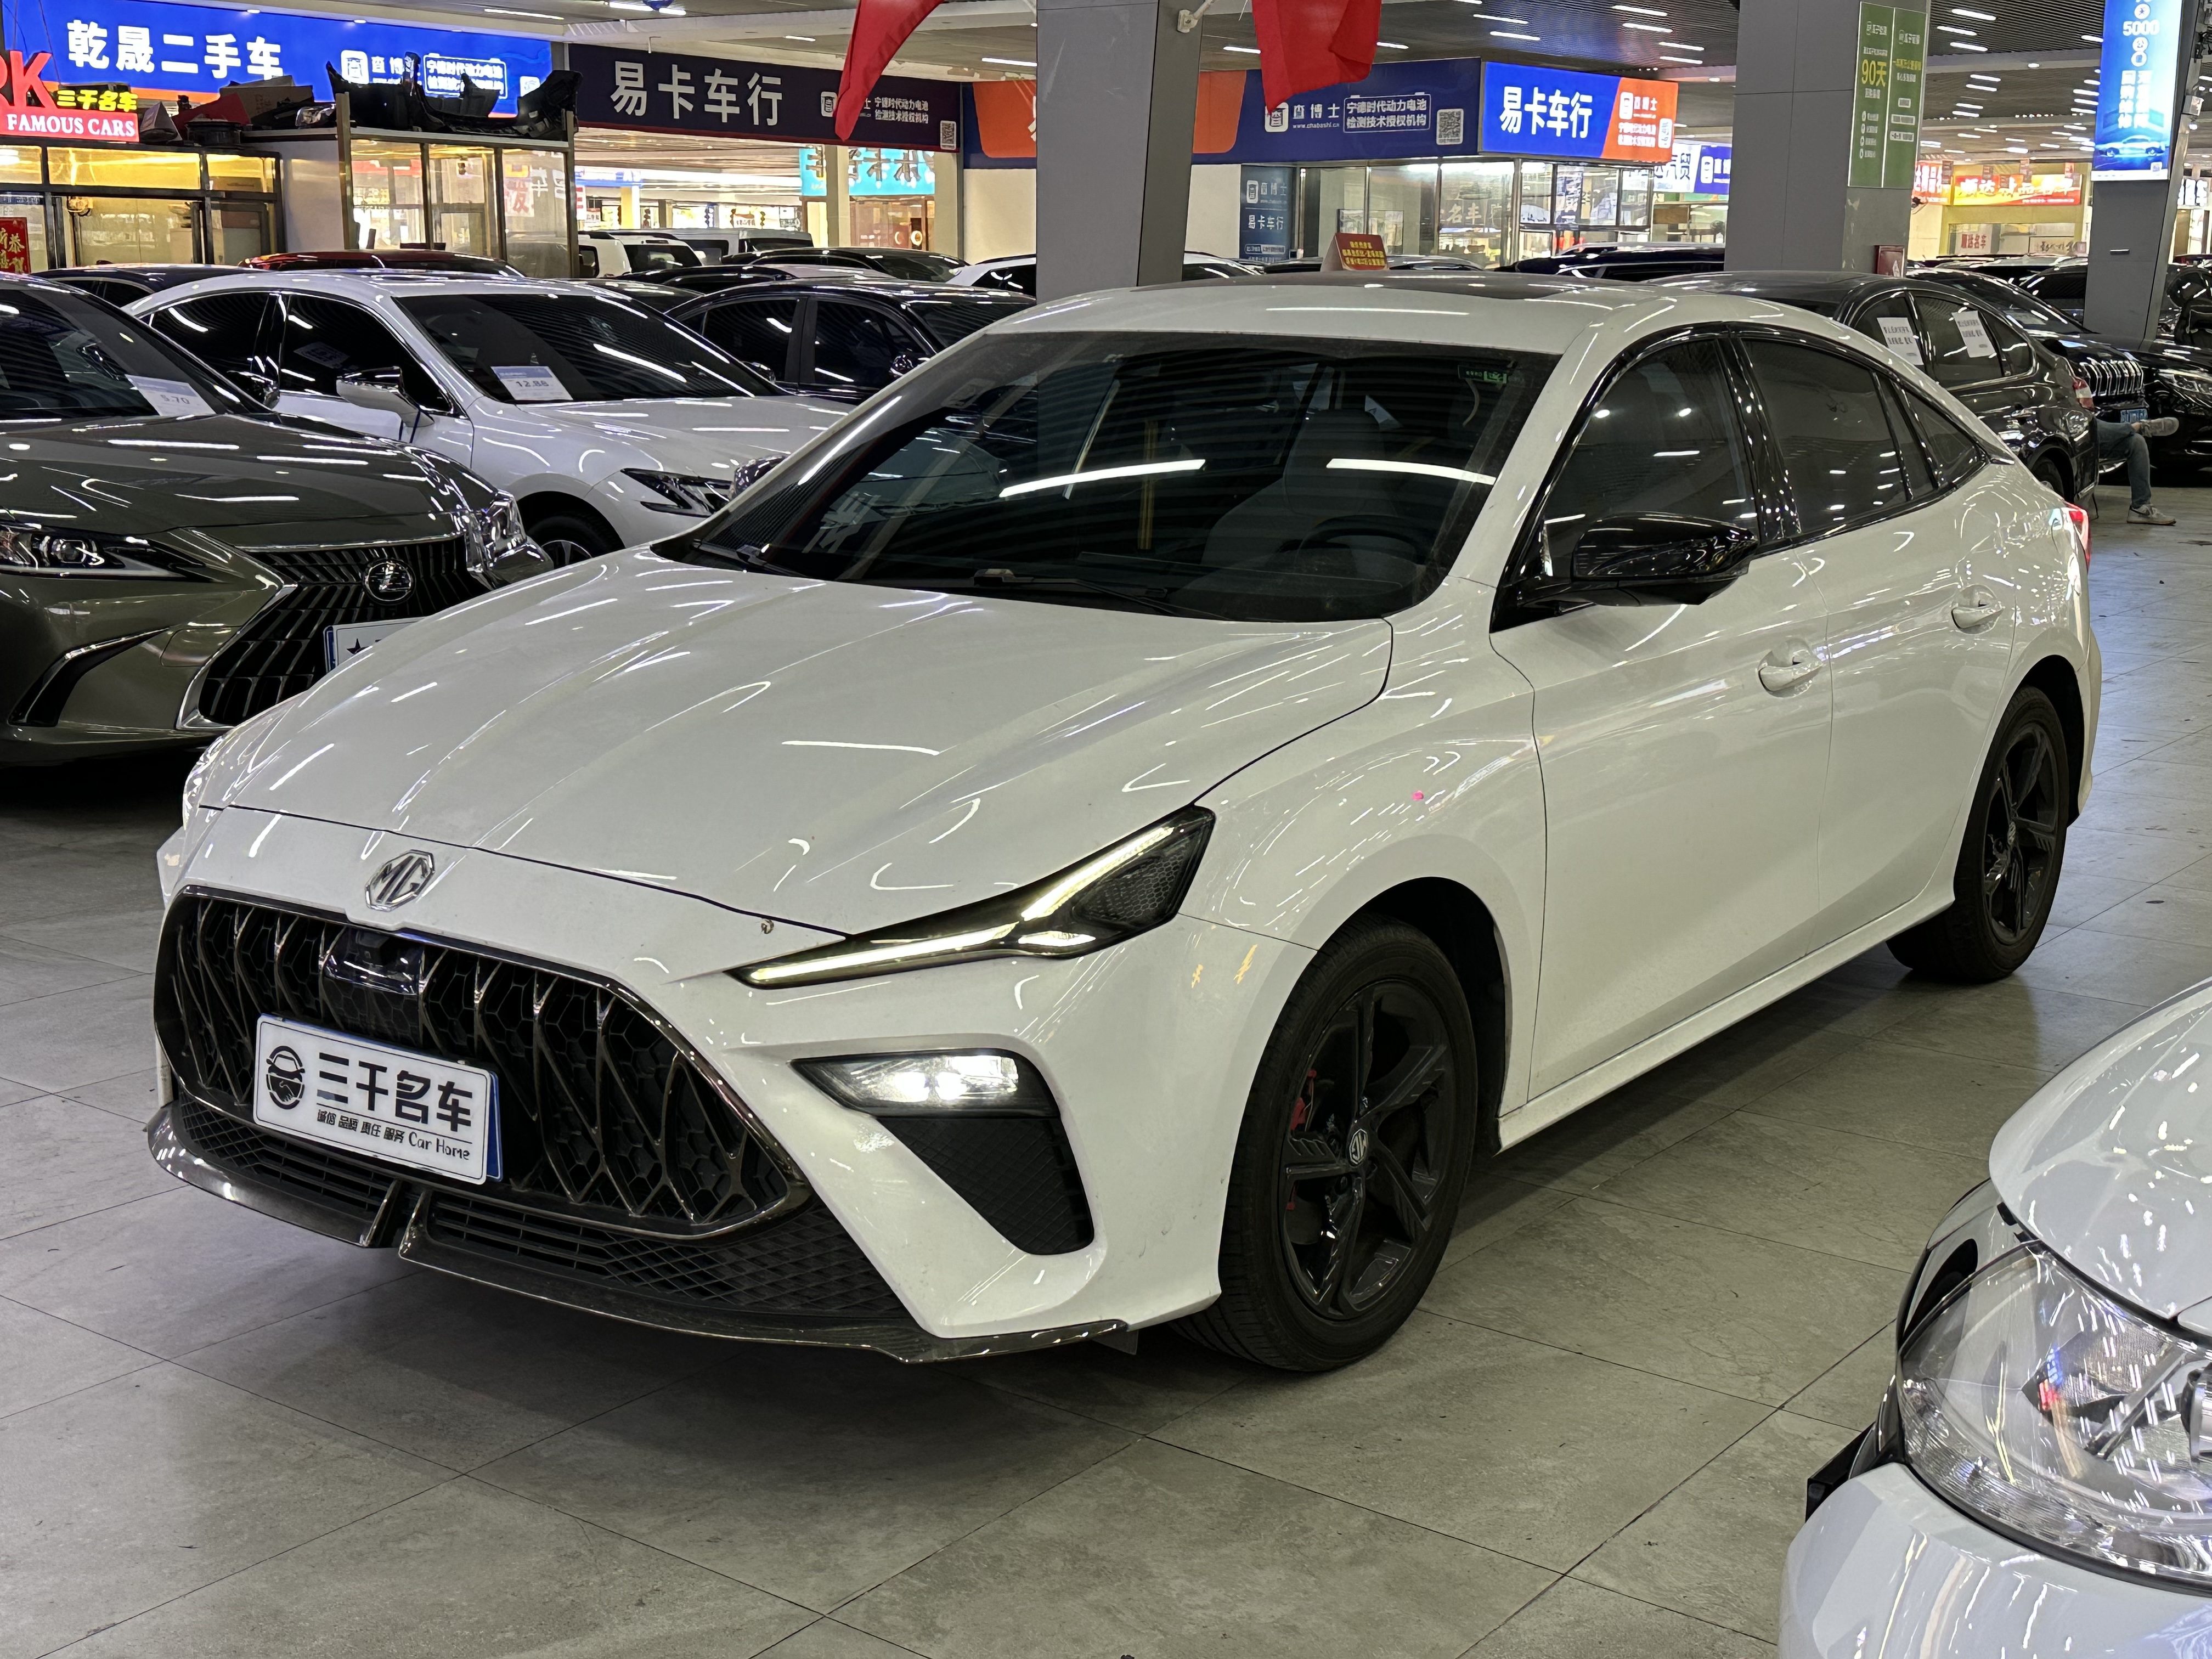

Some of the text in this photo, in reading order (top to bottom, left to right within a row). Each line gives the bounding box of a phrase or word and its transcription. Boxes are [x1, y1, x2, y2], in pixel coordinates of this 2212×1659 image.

[2123, 19, 2160, 36] 5000
[67, 19, 283, 80] 乾晟二手车
[0, 50, 58, 108] K
[1861, 59, 1887, 87] 90天
[610, 61, 782, 126] 易卡车行
[1346, 98, 1427, 114] 宁德时代动力电池
[7, 114, 136, 137] FAMOUS CARS
[1499, 86, 1593, 138] 易卡车行
[408, 1131, 432, 1150] Car
[436, 1137, 471, 1161] Home
